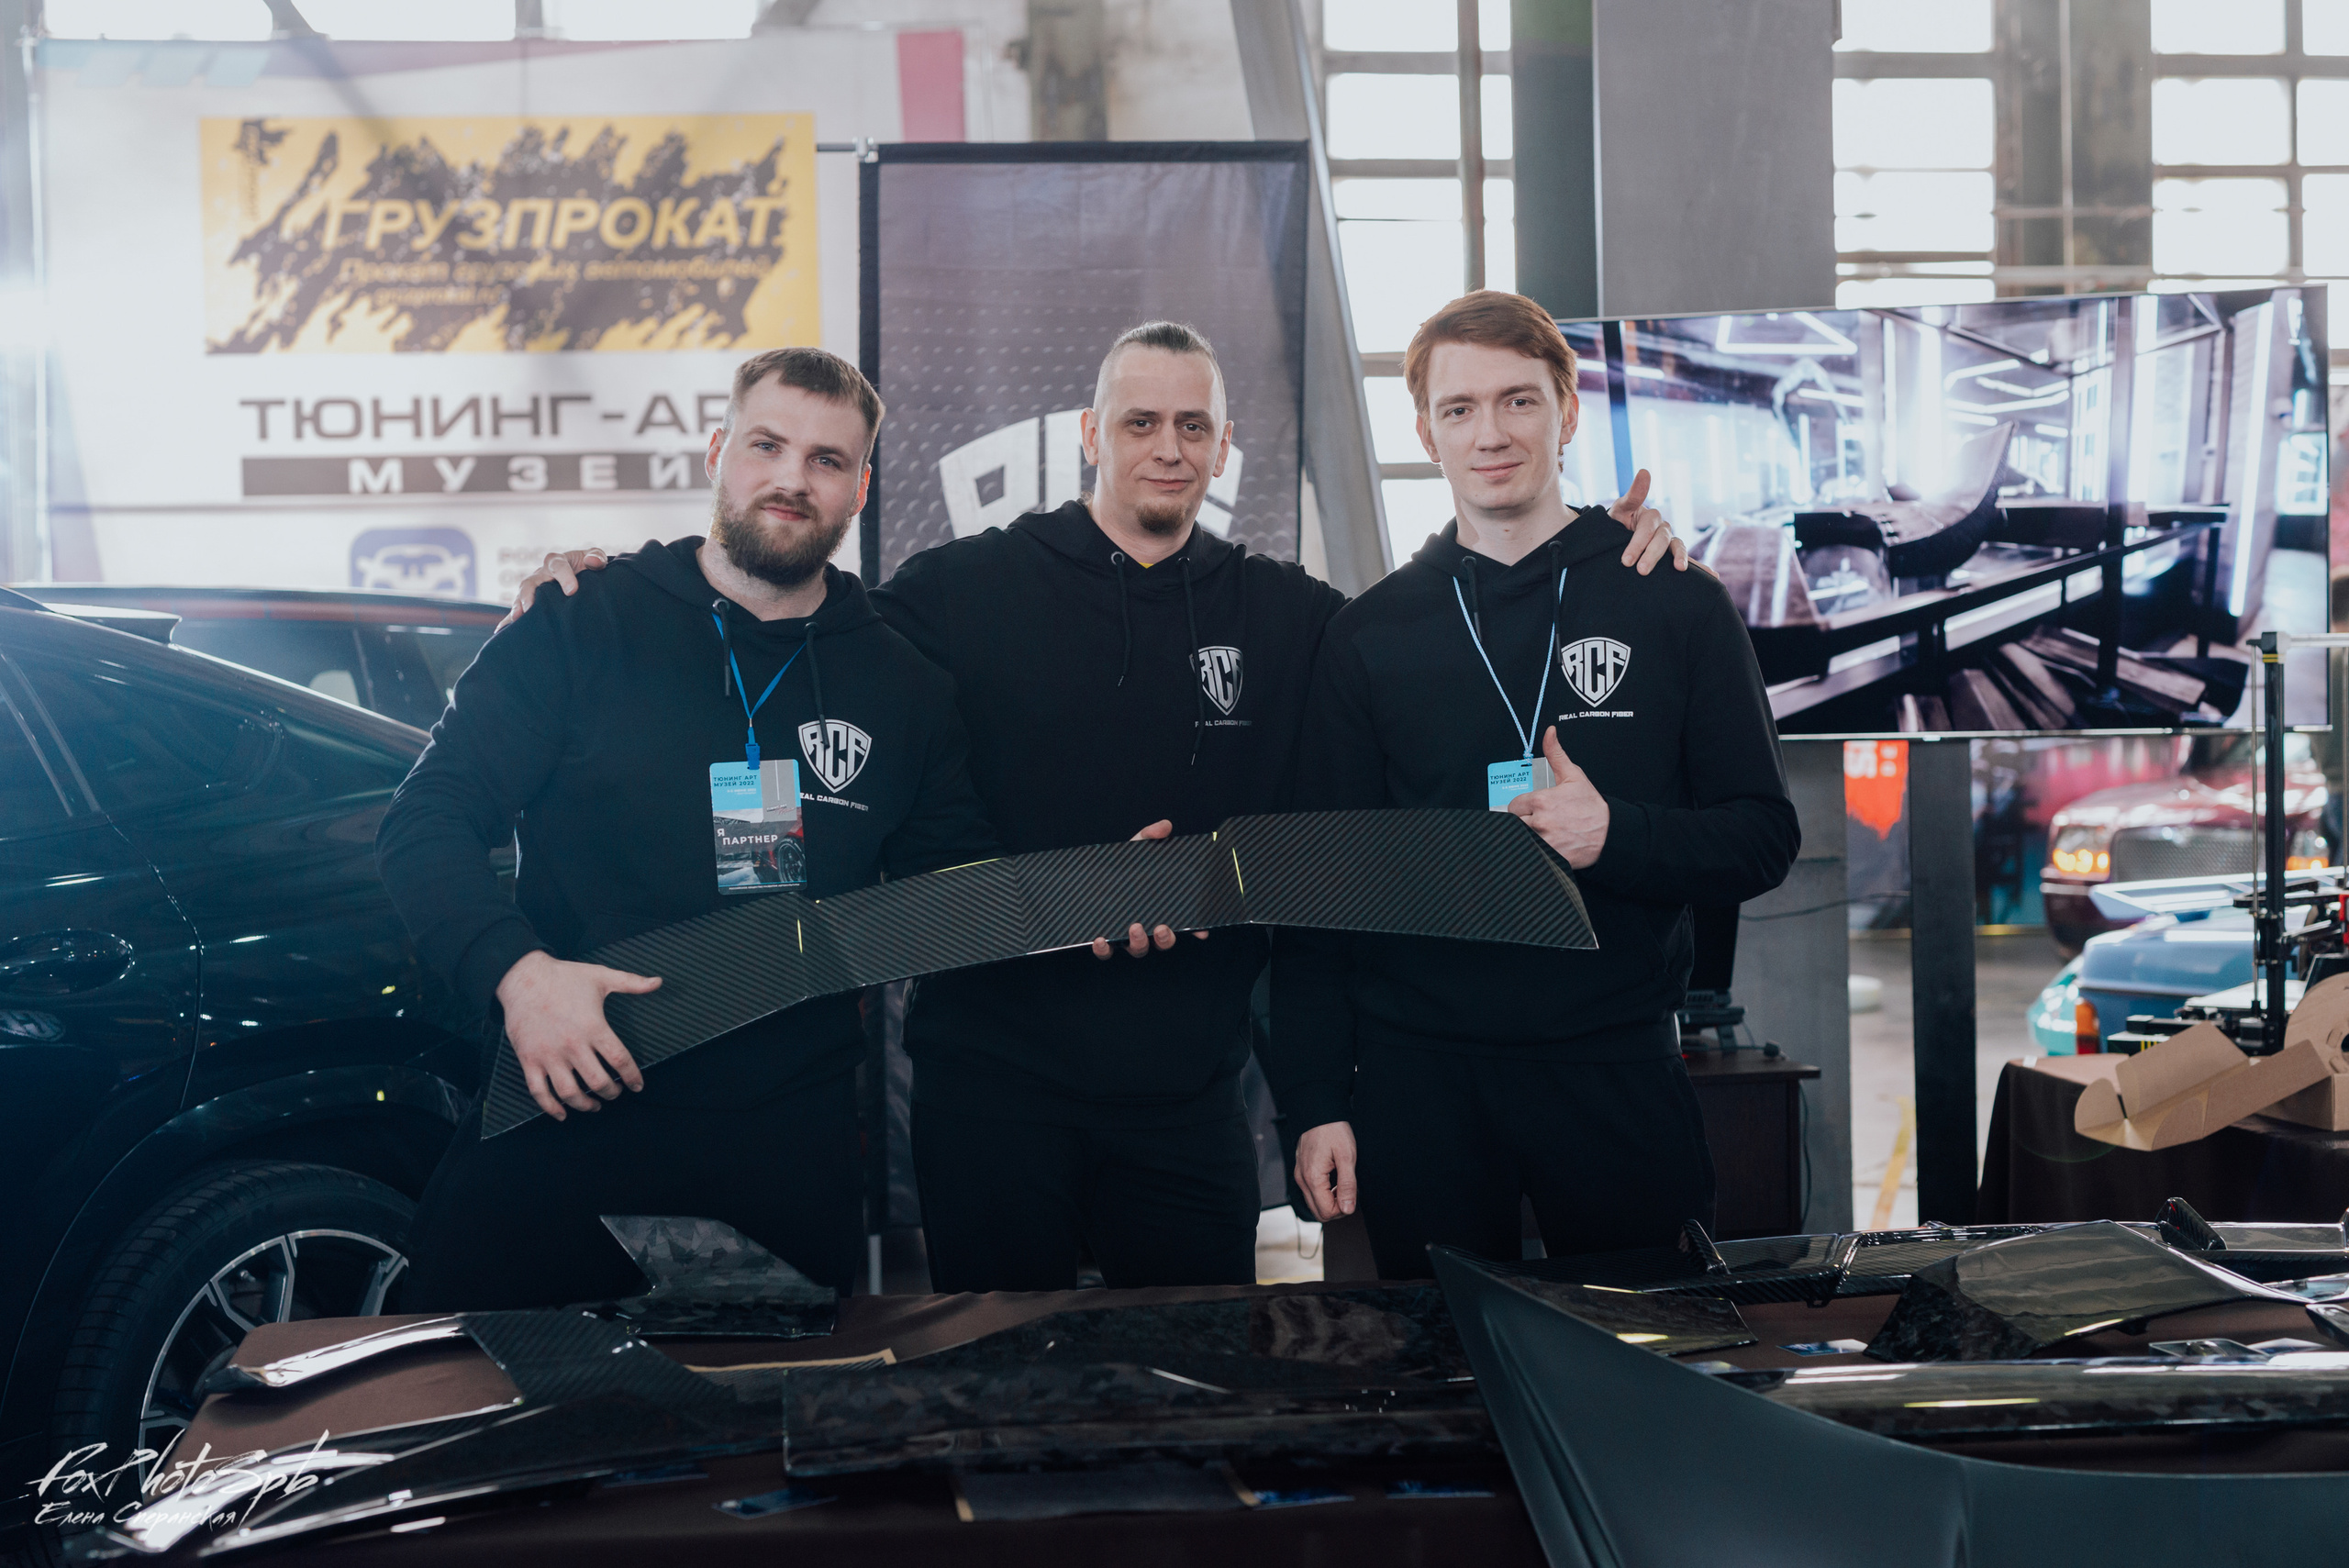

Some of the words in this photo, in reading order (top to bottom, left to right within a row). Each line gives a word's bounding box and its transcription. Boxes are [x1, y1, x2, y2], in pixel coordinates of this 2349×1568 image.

[321, 196, 784, 250] ГРУЗПРОКАТ
[240, 394, 732, 440] ТЮНИНГ-АР
[348, 451, 692, 493] МУЗЕЙ
[1197, 649, 1242, 709] RCF
[1562, 640, 1628, 702] RCF
[1558, 713, 1578, 721] REAL
[802, 723, 869, 787] RCF
[800, 793, 815, 801] EAL
[817, 795, 849, 806] CARBON
[851, 801, 869, 812] FIBER
[717, 828, 725, 837] Я
[722, 834, 778, 845] ПАРТНЕР
